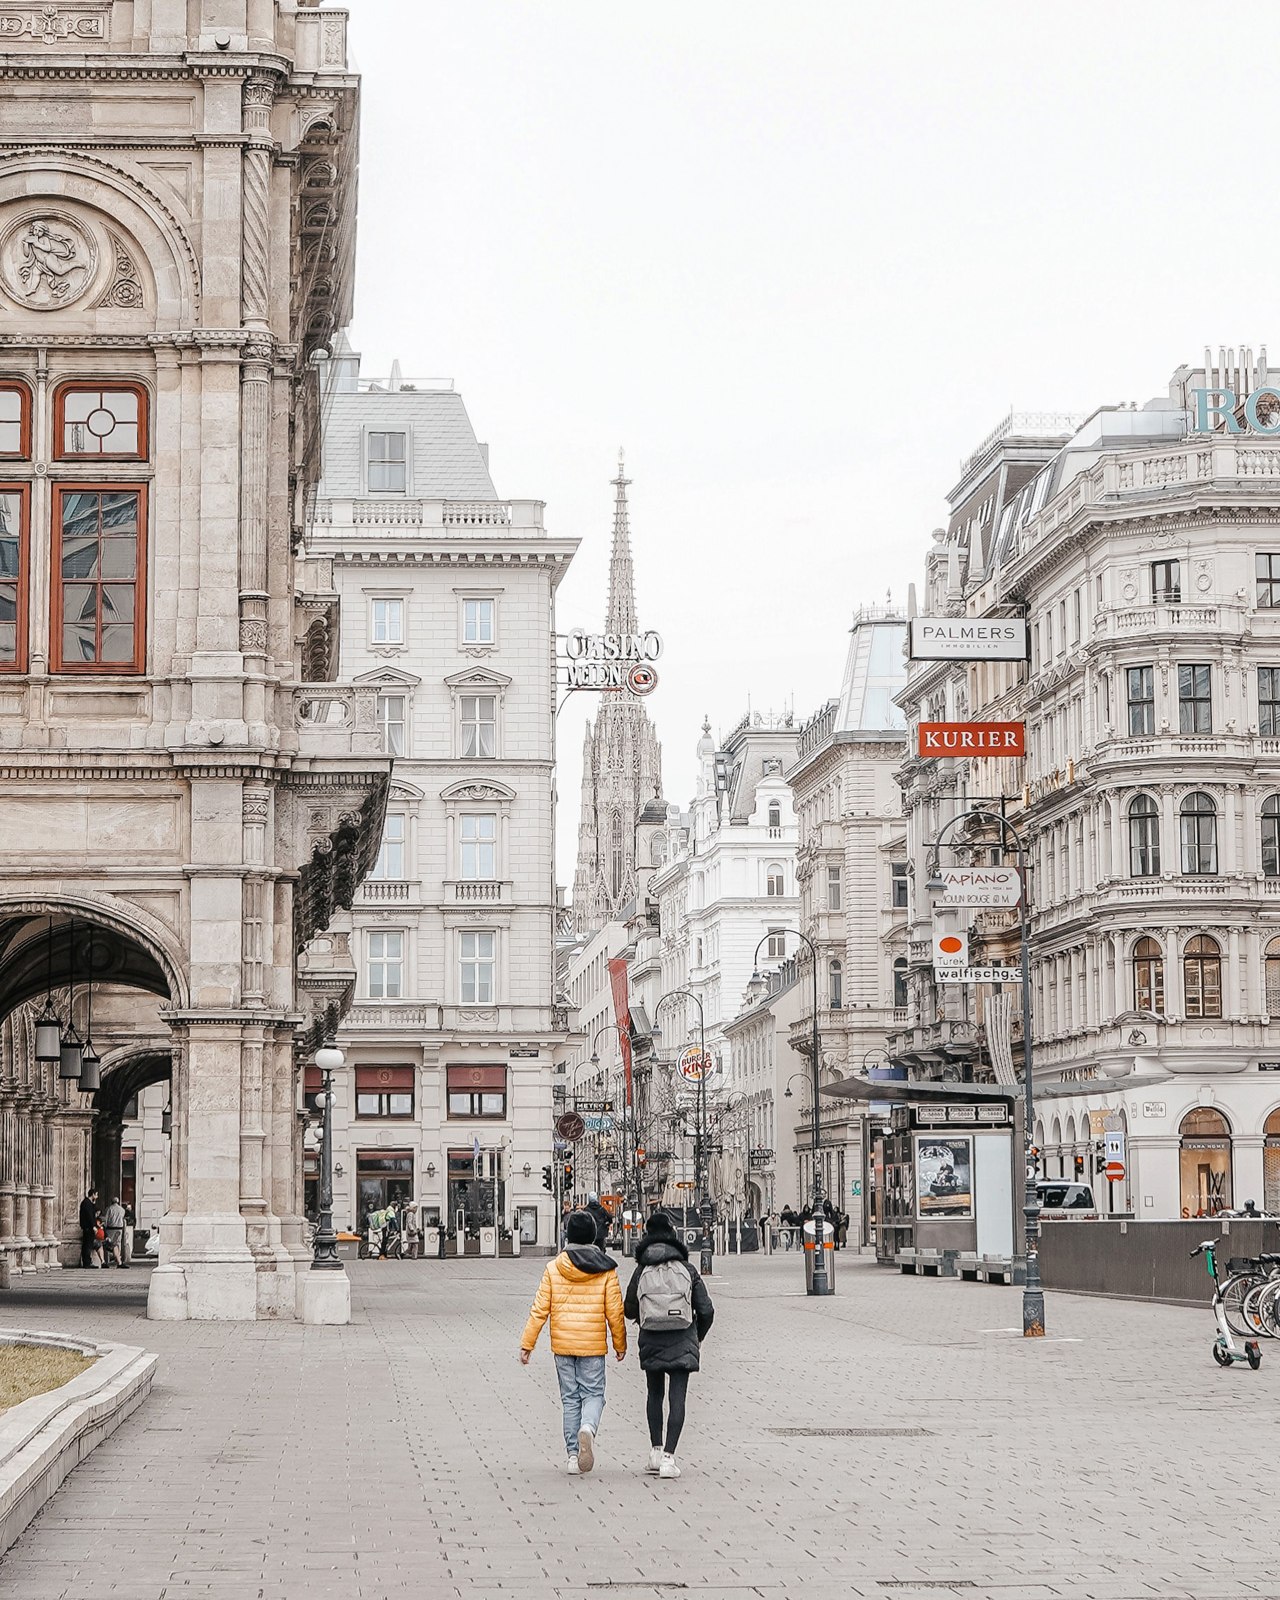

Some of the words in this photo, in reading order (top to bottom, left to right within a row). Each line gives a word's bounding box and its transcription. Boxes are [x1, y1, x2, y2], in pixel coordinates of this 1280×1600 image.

[1191, 387, 1280, 434] RO
[923, 627, 1015, 639] PALMERS
[566, 628, 664, 661] CASINO
[925, 731, 1018, 747] KURIER
[937, 957, 965, 965] Turek
[681, 1052, 711, 1067] BURGR
[683, 1059, 712, 1077] KING
